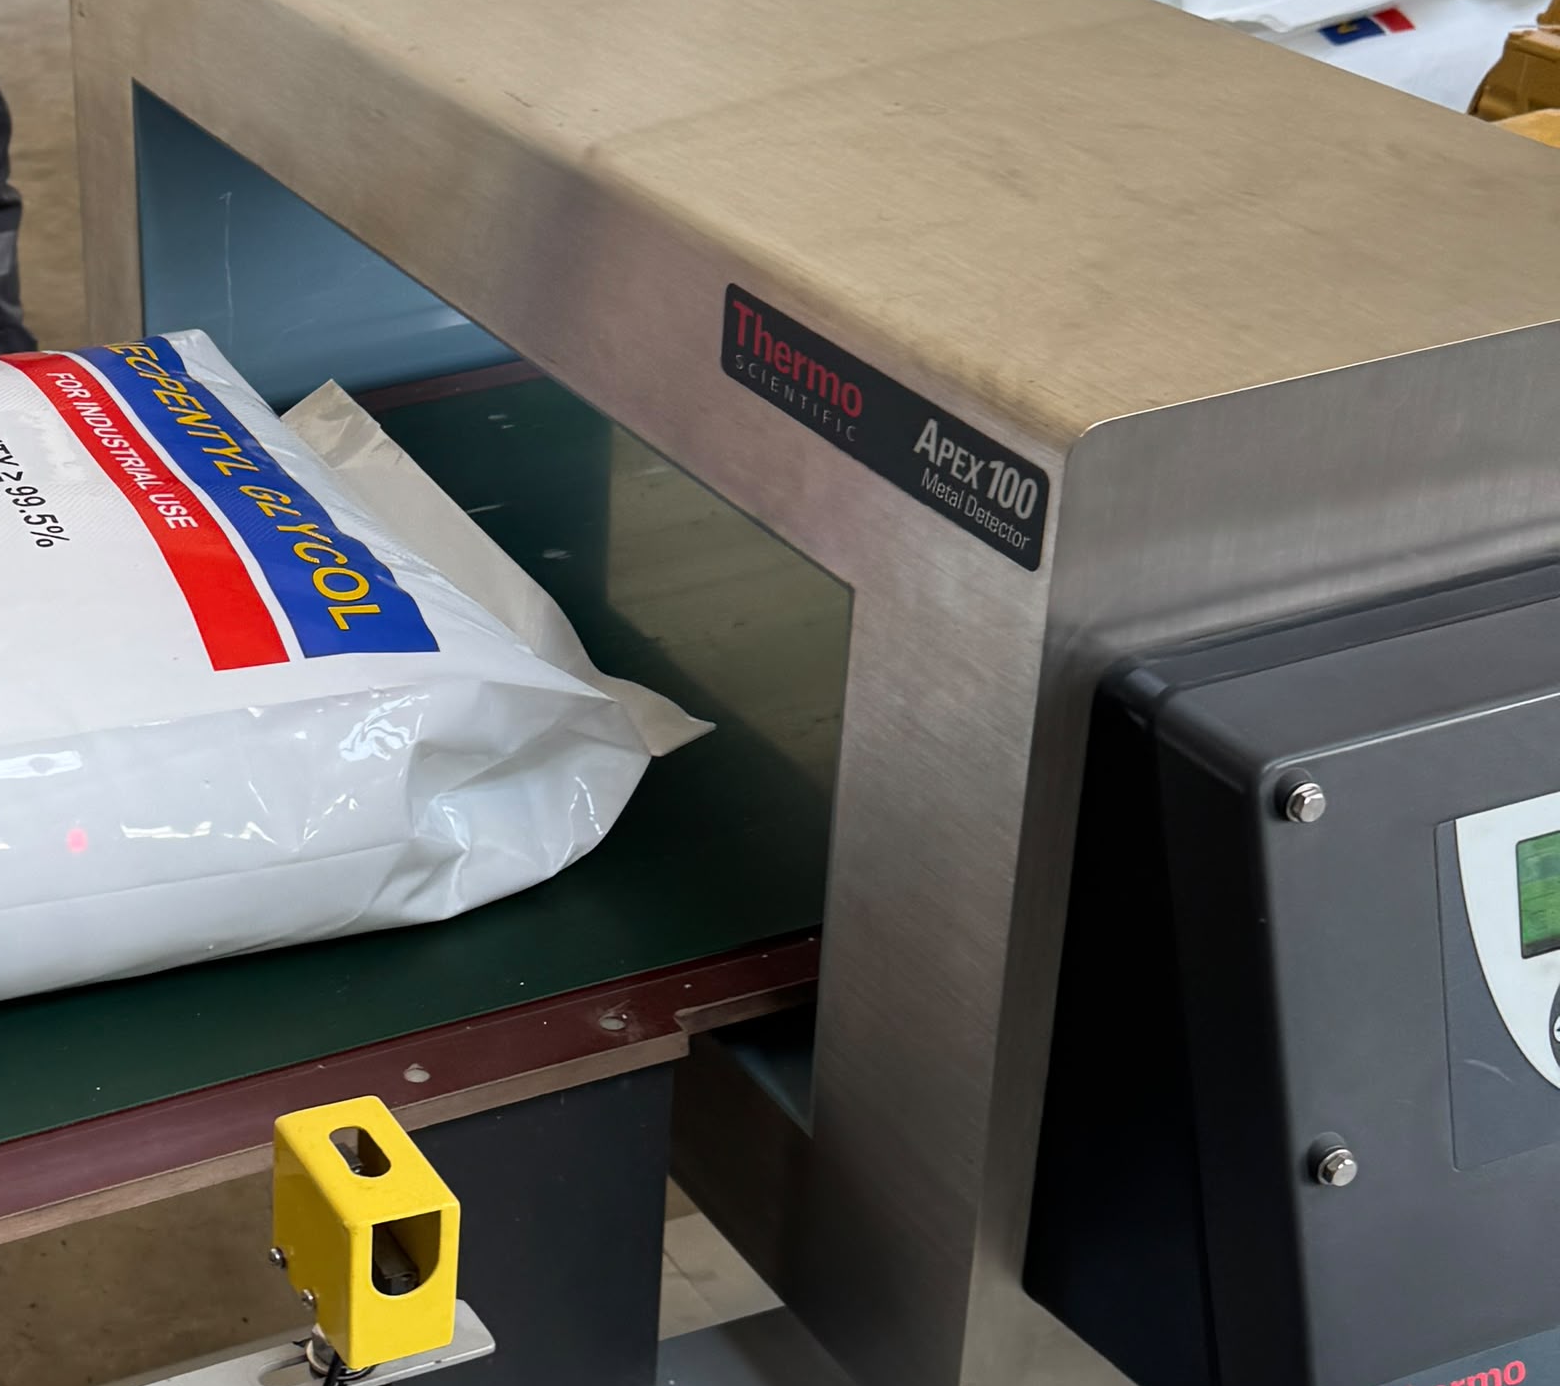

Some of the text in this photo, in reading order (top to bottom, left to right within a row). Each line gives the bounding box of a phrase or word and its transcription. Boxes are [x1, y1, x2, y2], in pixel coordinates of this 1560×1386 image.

[733, 300, 863, 418] Thermo
[735, 354, 857, 443] SCIENTIFIC
[46, 371, 199, 530] FOR INDUSTRIAL USE
[103, 341, 382, 632] EOPENTYL GLYCOL
[912, 418, 1038, 521] APEX 100
[920, 467, 1031, 551] Metal Detector
